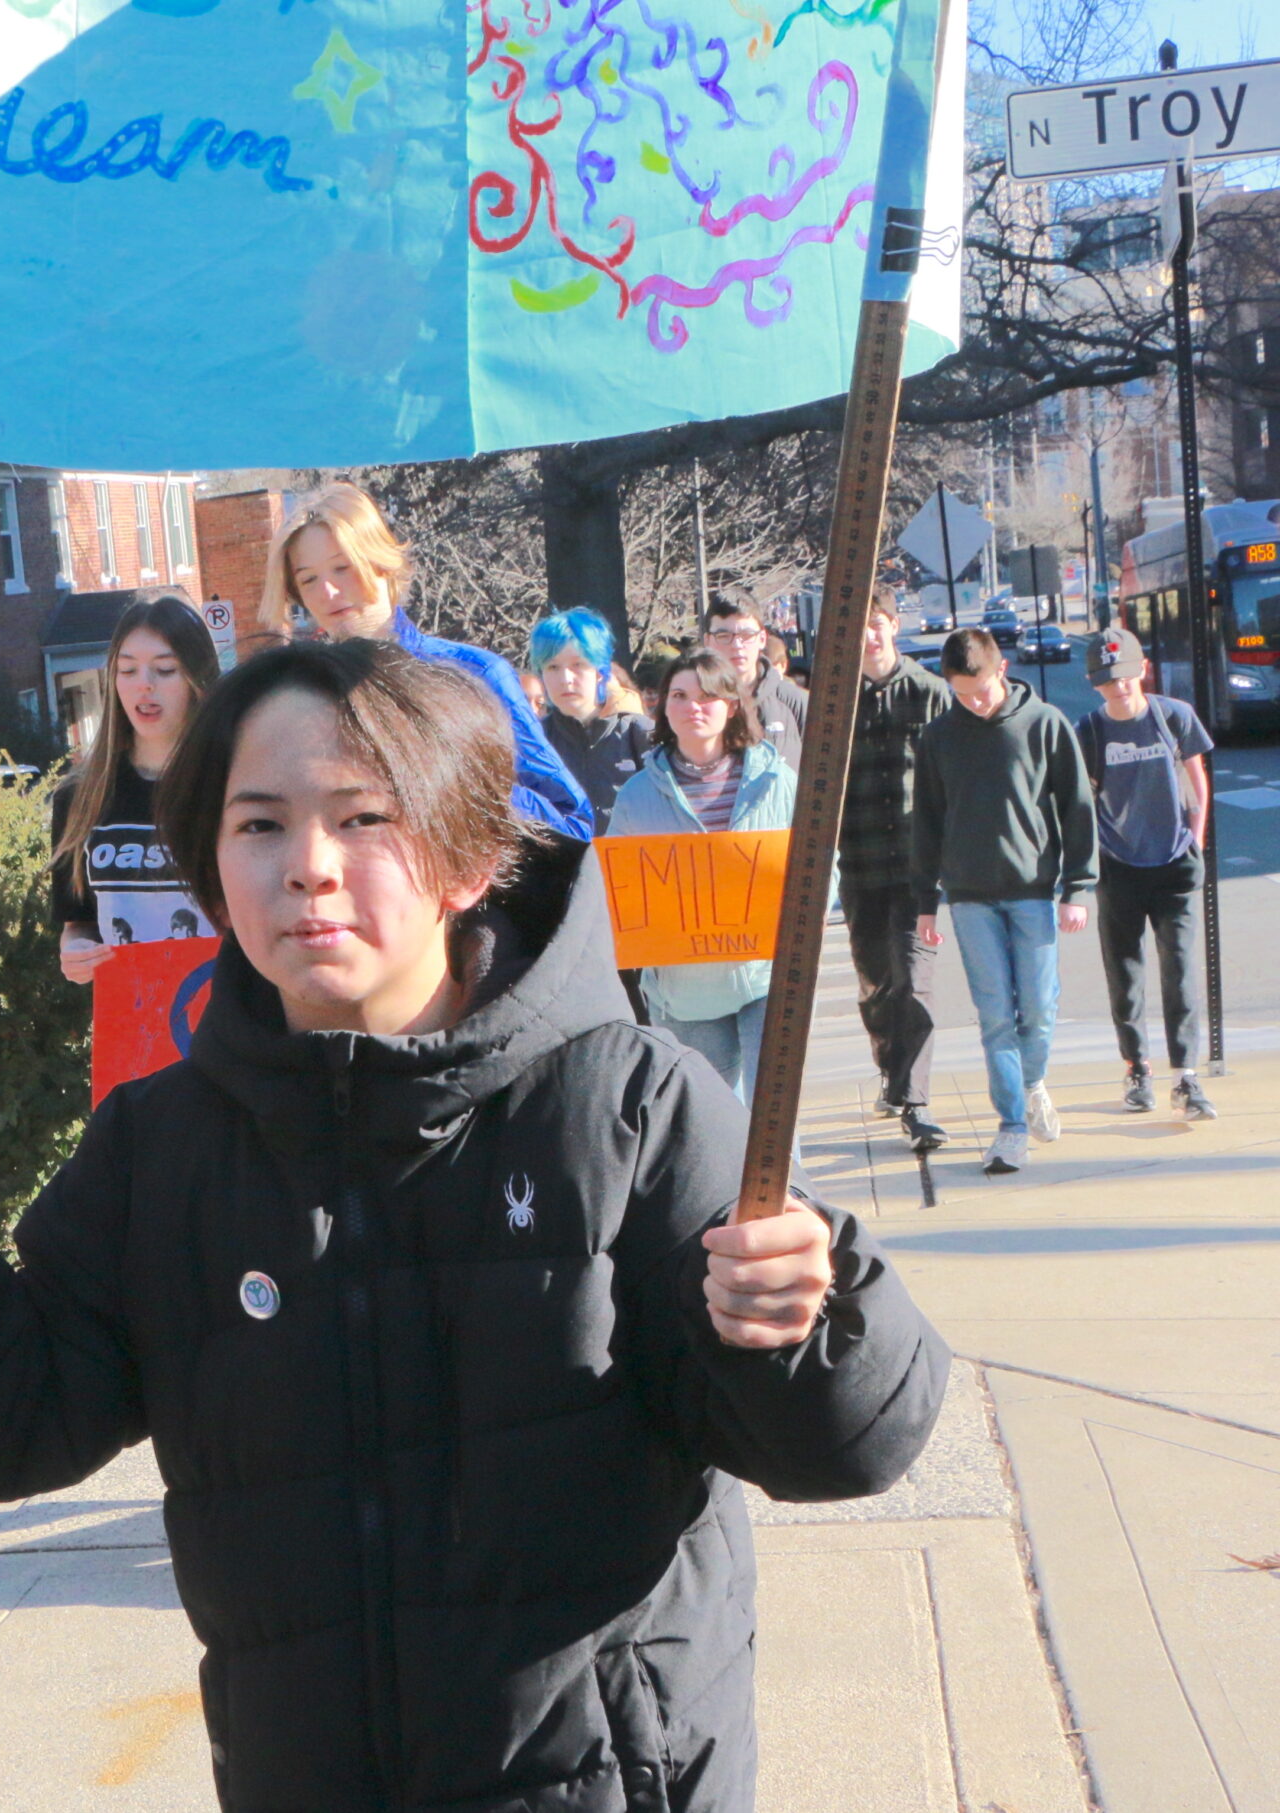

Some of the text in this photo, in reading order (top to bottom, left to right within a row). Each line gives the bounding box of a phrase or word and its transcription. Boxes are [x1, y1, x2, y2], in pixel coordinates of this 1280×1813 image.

[1029, 83, 1248, 149] N Troy
[1247, 543, 1276, 564] A58
[91, 843, 176, 869] oas
[605, 840, 761, 932] EMILY
[690, 933, 759, 955] FLYNN
